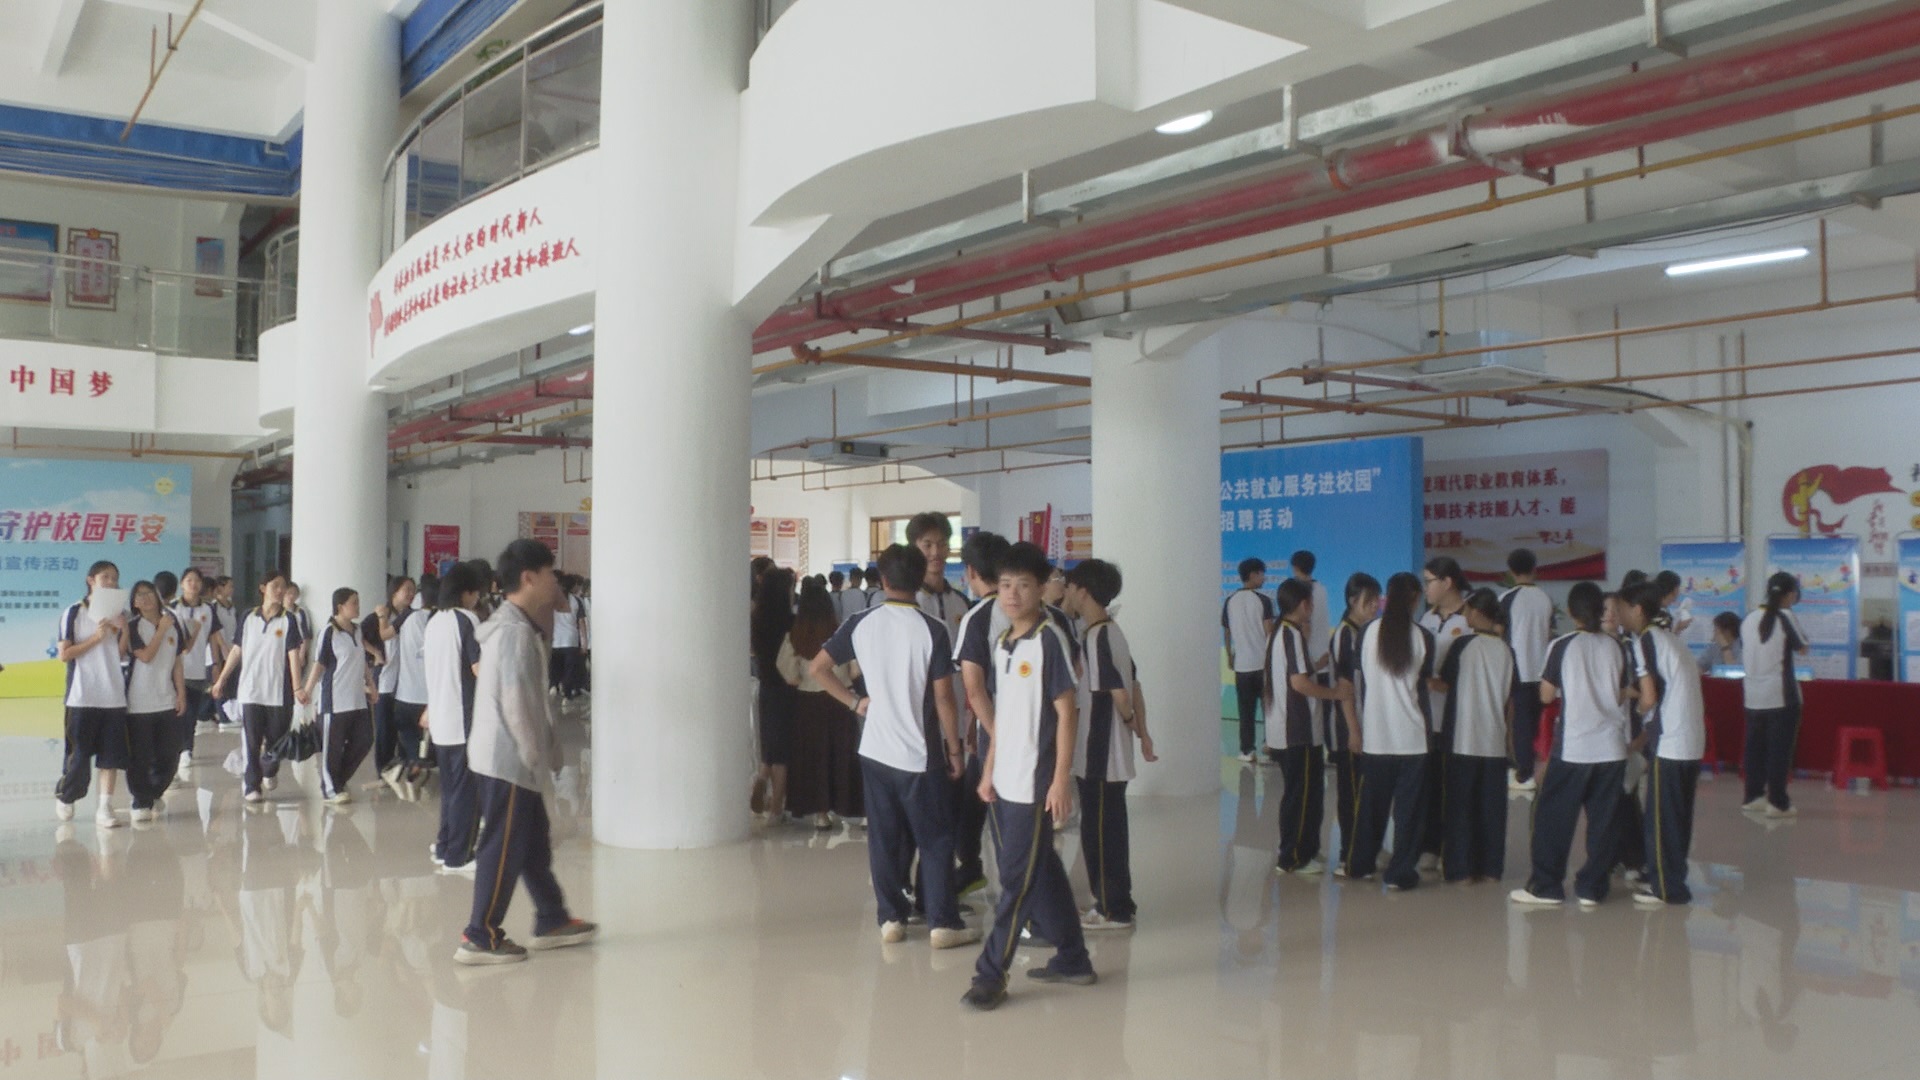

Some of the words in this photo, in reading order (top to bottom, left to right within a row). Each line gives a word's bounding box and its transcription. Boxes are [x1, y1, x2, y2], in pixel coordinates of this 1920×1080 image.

[10, 365, 113, 397] 中国梦
[0, 511, 167, 543] 守护校园平安
[1220, 506, 1293, 532] 招聘活动
[0, 555, 79, 572] 宣传活动
